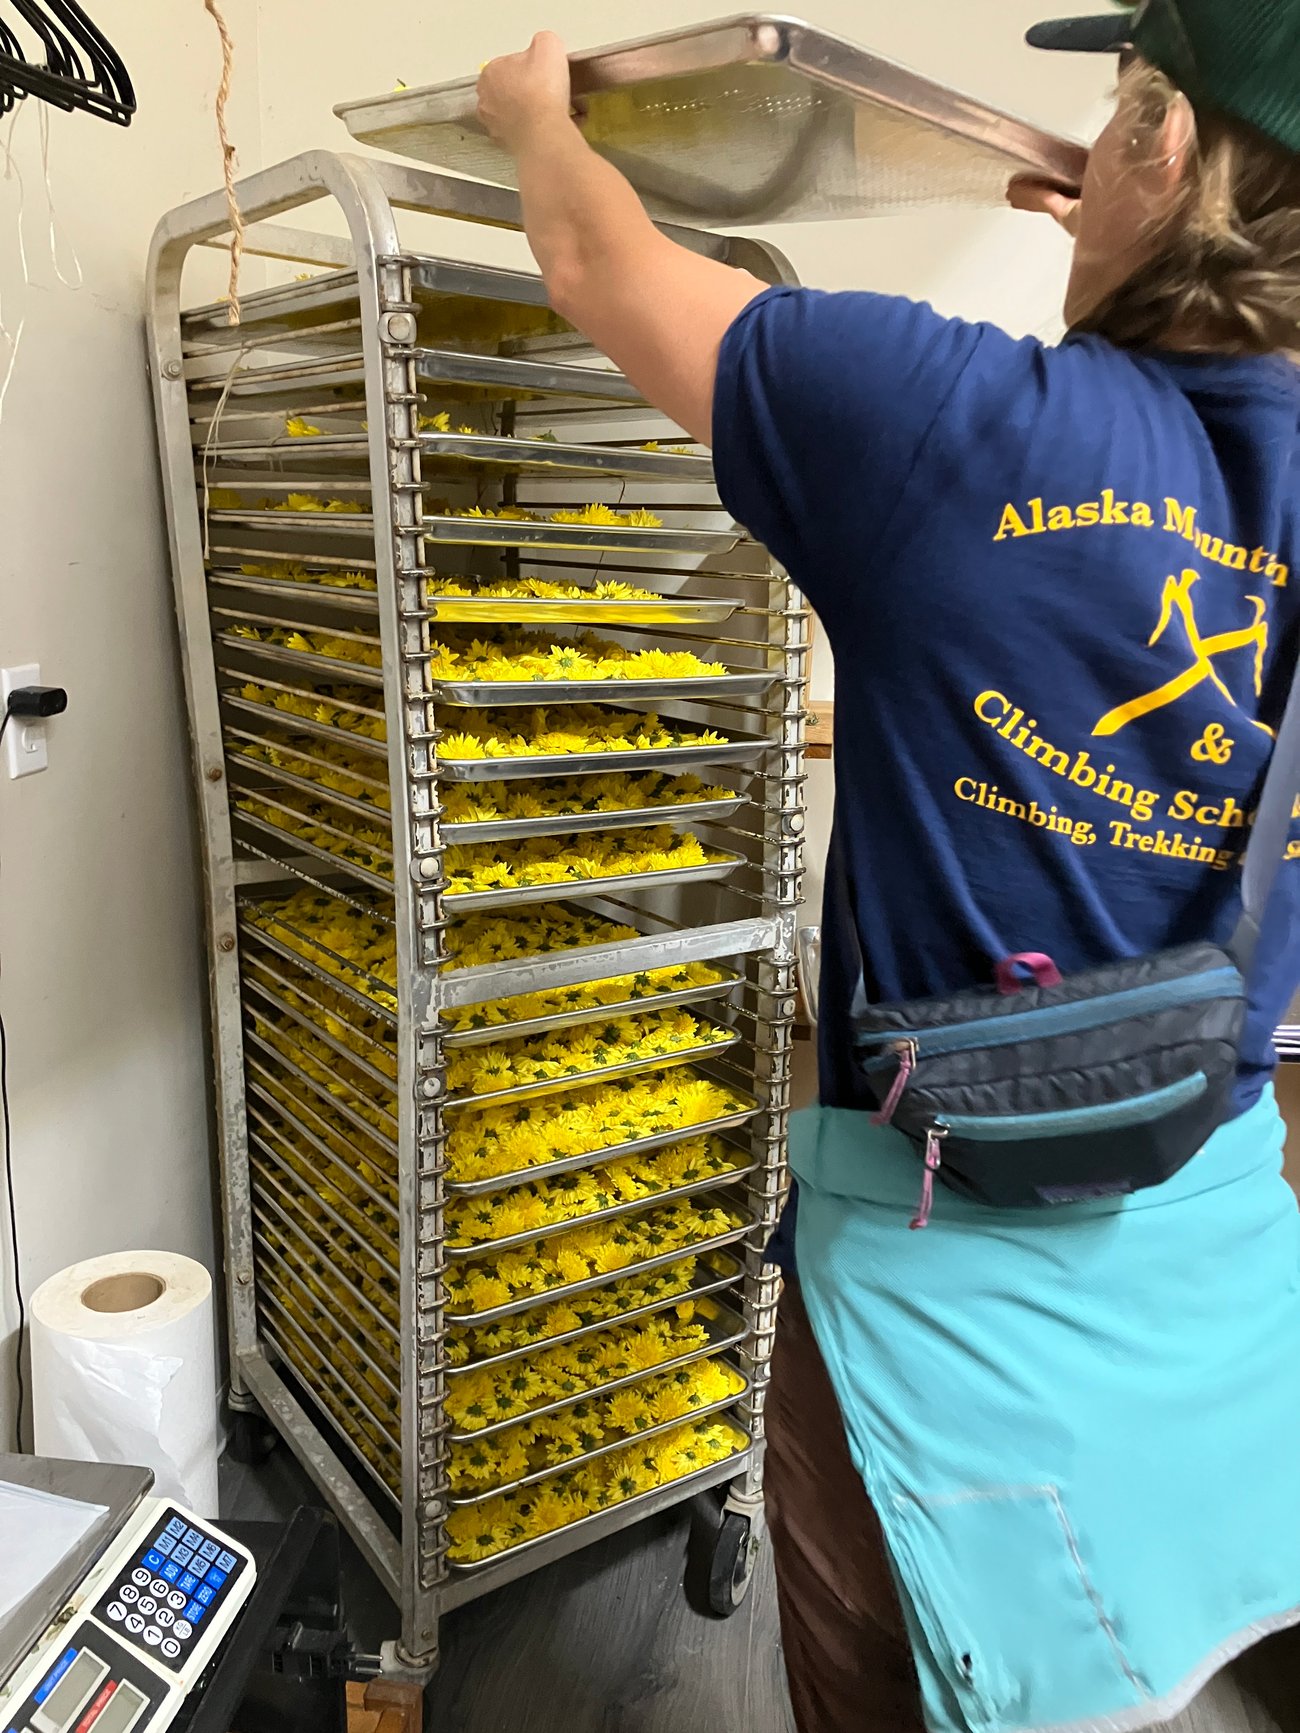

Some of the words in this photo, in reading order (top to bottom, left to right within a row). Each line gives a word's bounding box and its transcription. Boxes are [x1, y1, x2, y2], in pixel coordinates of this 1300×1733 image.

[992, 488, 1154, 541] Alaska
[1190, 722, 1235, 765] &
[973, 690, 1159, 821] Climbing
[953, 776, 1097, 845] Climbing,
[1109, 820, 1234, 870] Trekking
[169, 1520, 184, 1538] M2
[158, 1536, 174, 1551] M1
[186, 1532, 200, 1549] M4
[148, 1554, 160, 1565] C
[174, 1547, 190, 1564] M3
[219, 1554, 233, 1571] M7
[135, 1570, 149, 1583] 9
[122, 1587, 137, 1600] 8
[152, 1581, 167, 1594] 6
[140, 1598, 155, 1612] 5
[170, 1592, 184, 1606] 3
[109, 1603, 123, 1617] 7
[158, 1610, 173, 1625] 2
[129, 1616, 143, 1629] 4
[147, 1627, 161, 1640] 1
[164, 1640, 179, 1655] 0
